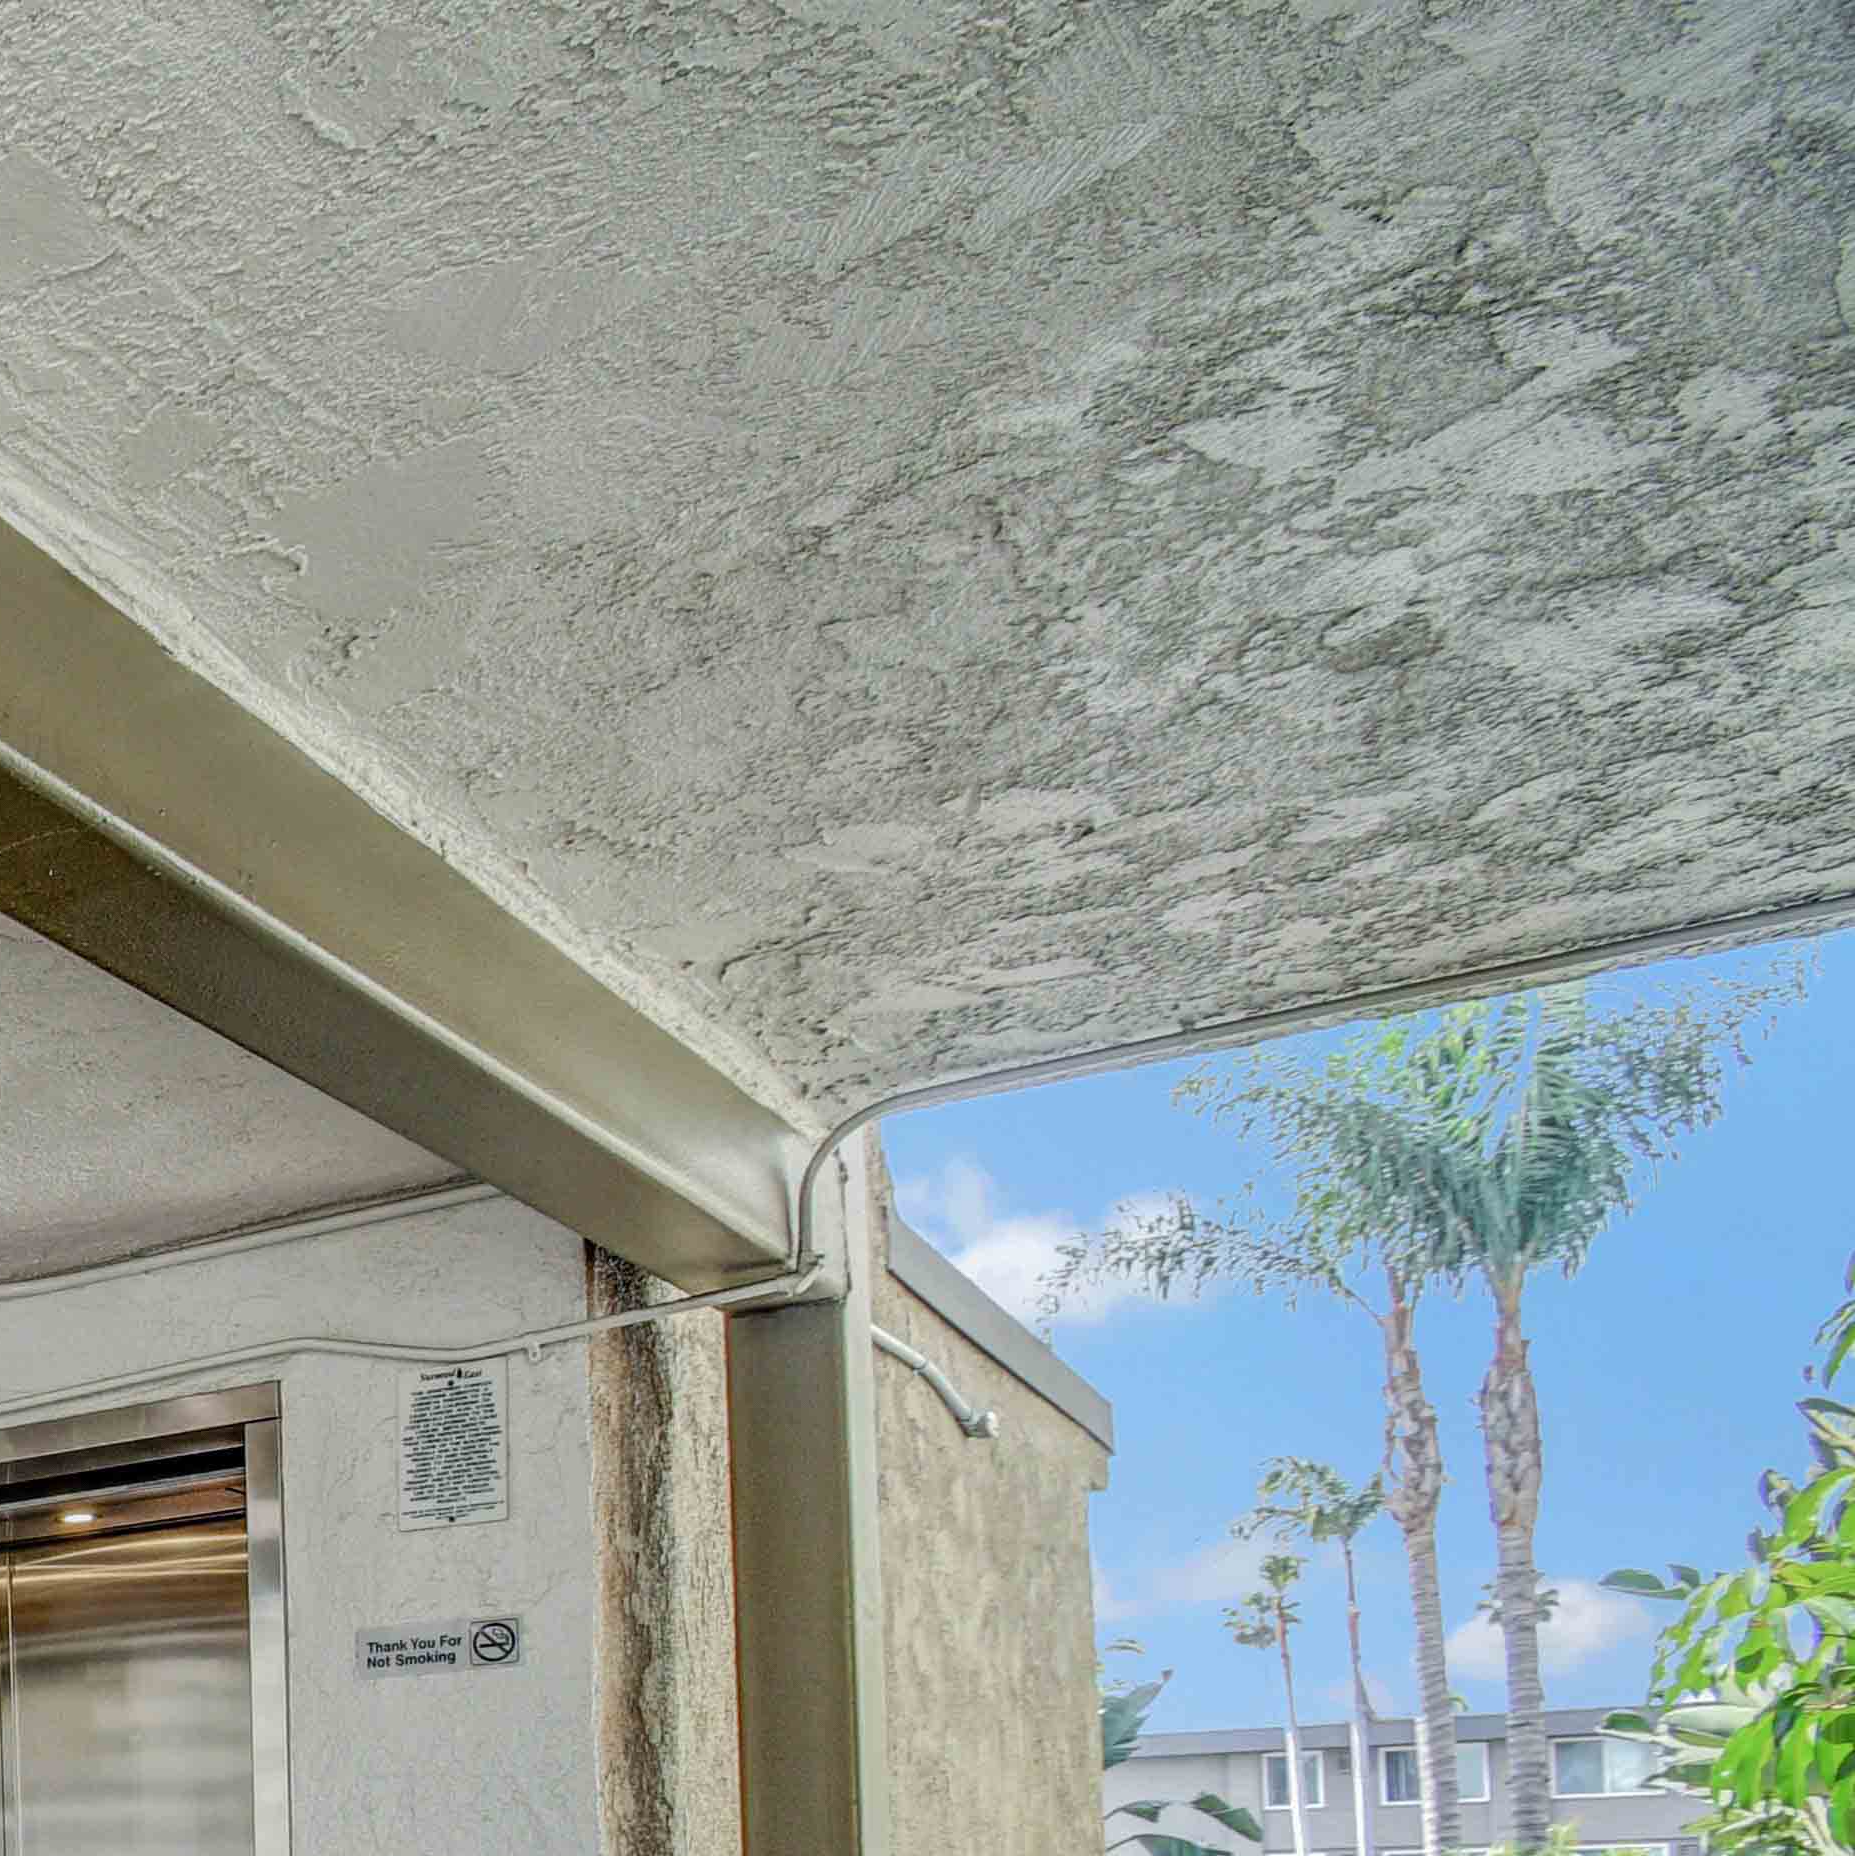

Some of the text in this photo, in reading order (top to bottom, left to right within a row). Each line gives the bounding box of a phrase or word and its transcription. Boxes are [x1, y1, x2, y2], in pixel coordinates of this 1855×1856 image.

[366, 1634, 462, 1654] Thank You For
[366, 1650, 456, 1670] Not Smoking
